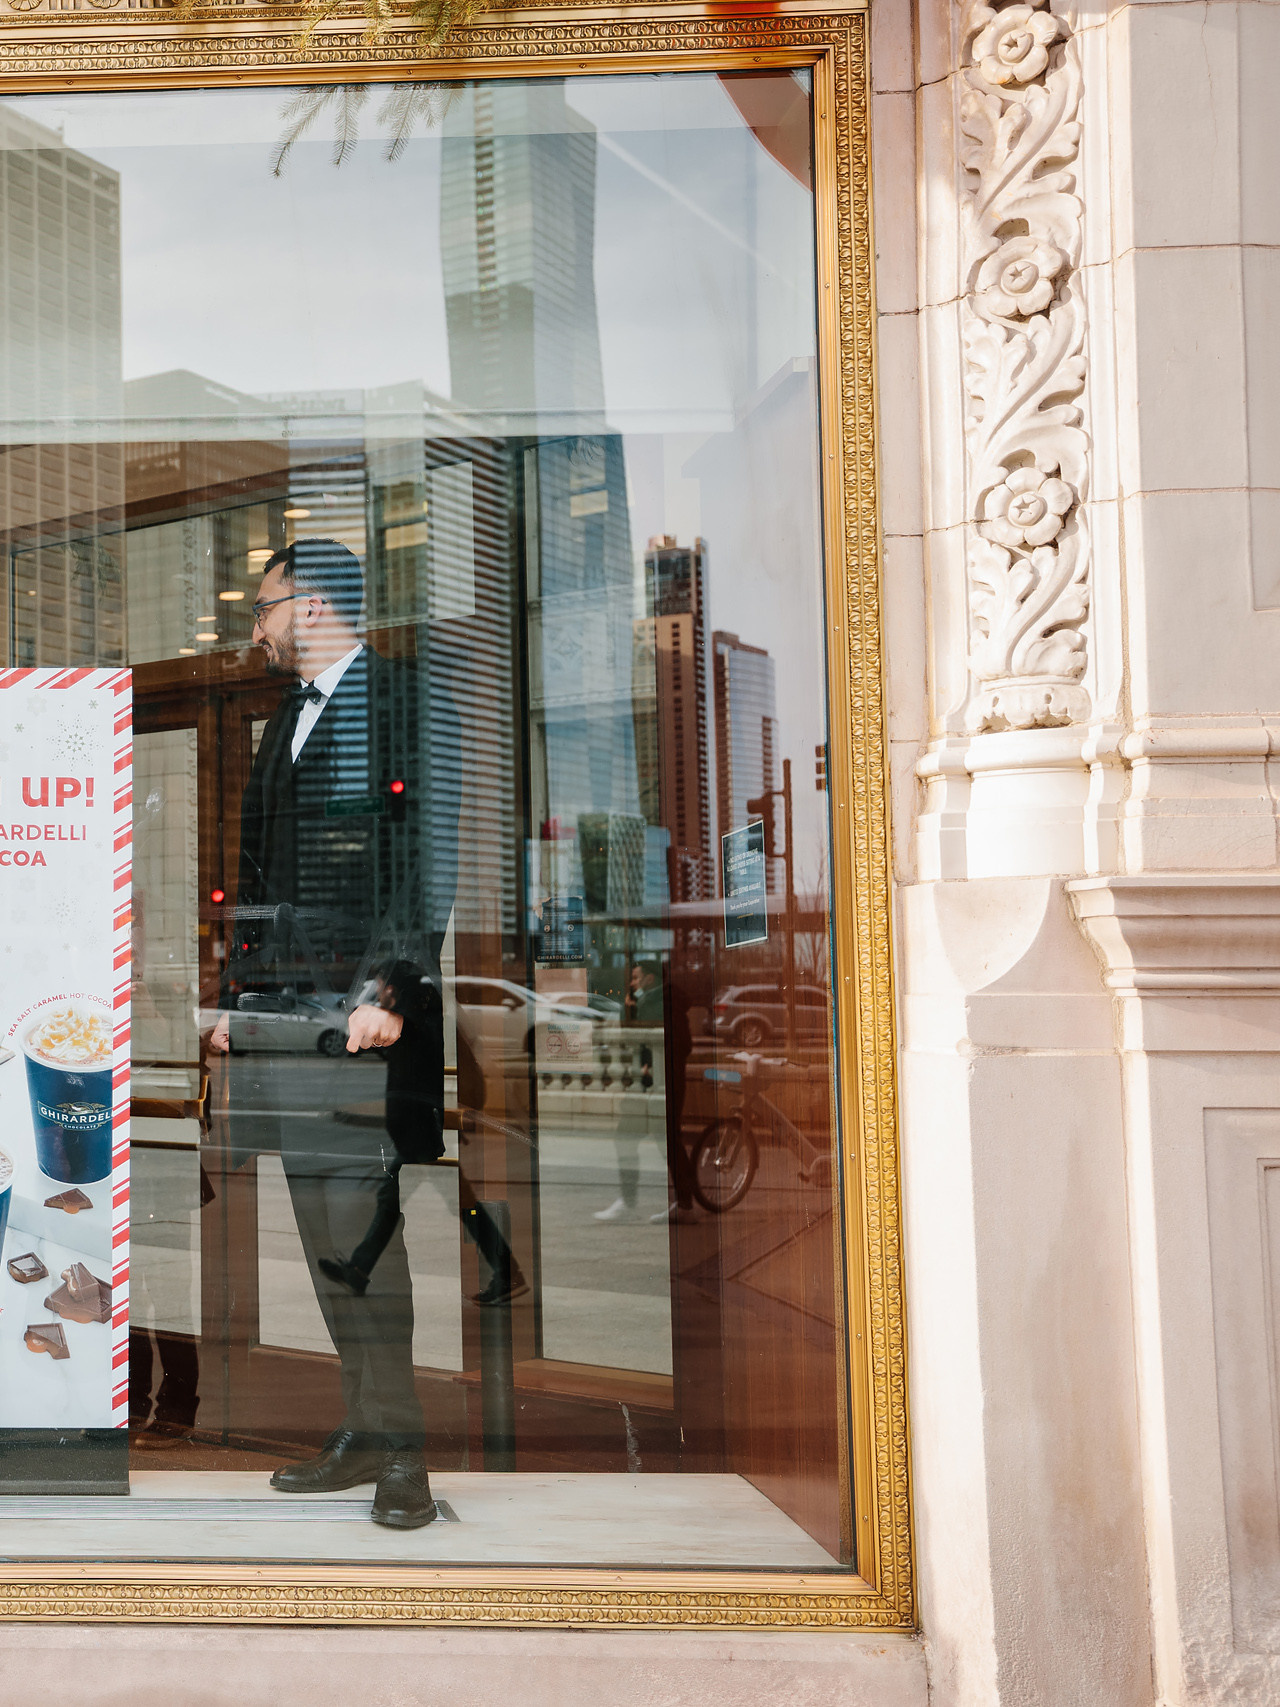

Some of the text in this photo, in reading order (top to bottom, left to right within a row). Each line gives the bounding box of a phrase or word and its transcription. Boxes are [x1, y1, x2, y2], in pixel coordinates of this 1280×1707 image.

[21, 777, 95, 807] UP!
[8, 1022, 18, 1037] SEA
[16, 1008, 32, 1022] SALT
[32, 993, 68, 1010] CARAMEL
[87, 994, 112, 1009] COCOA
